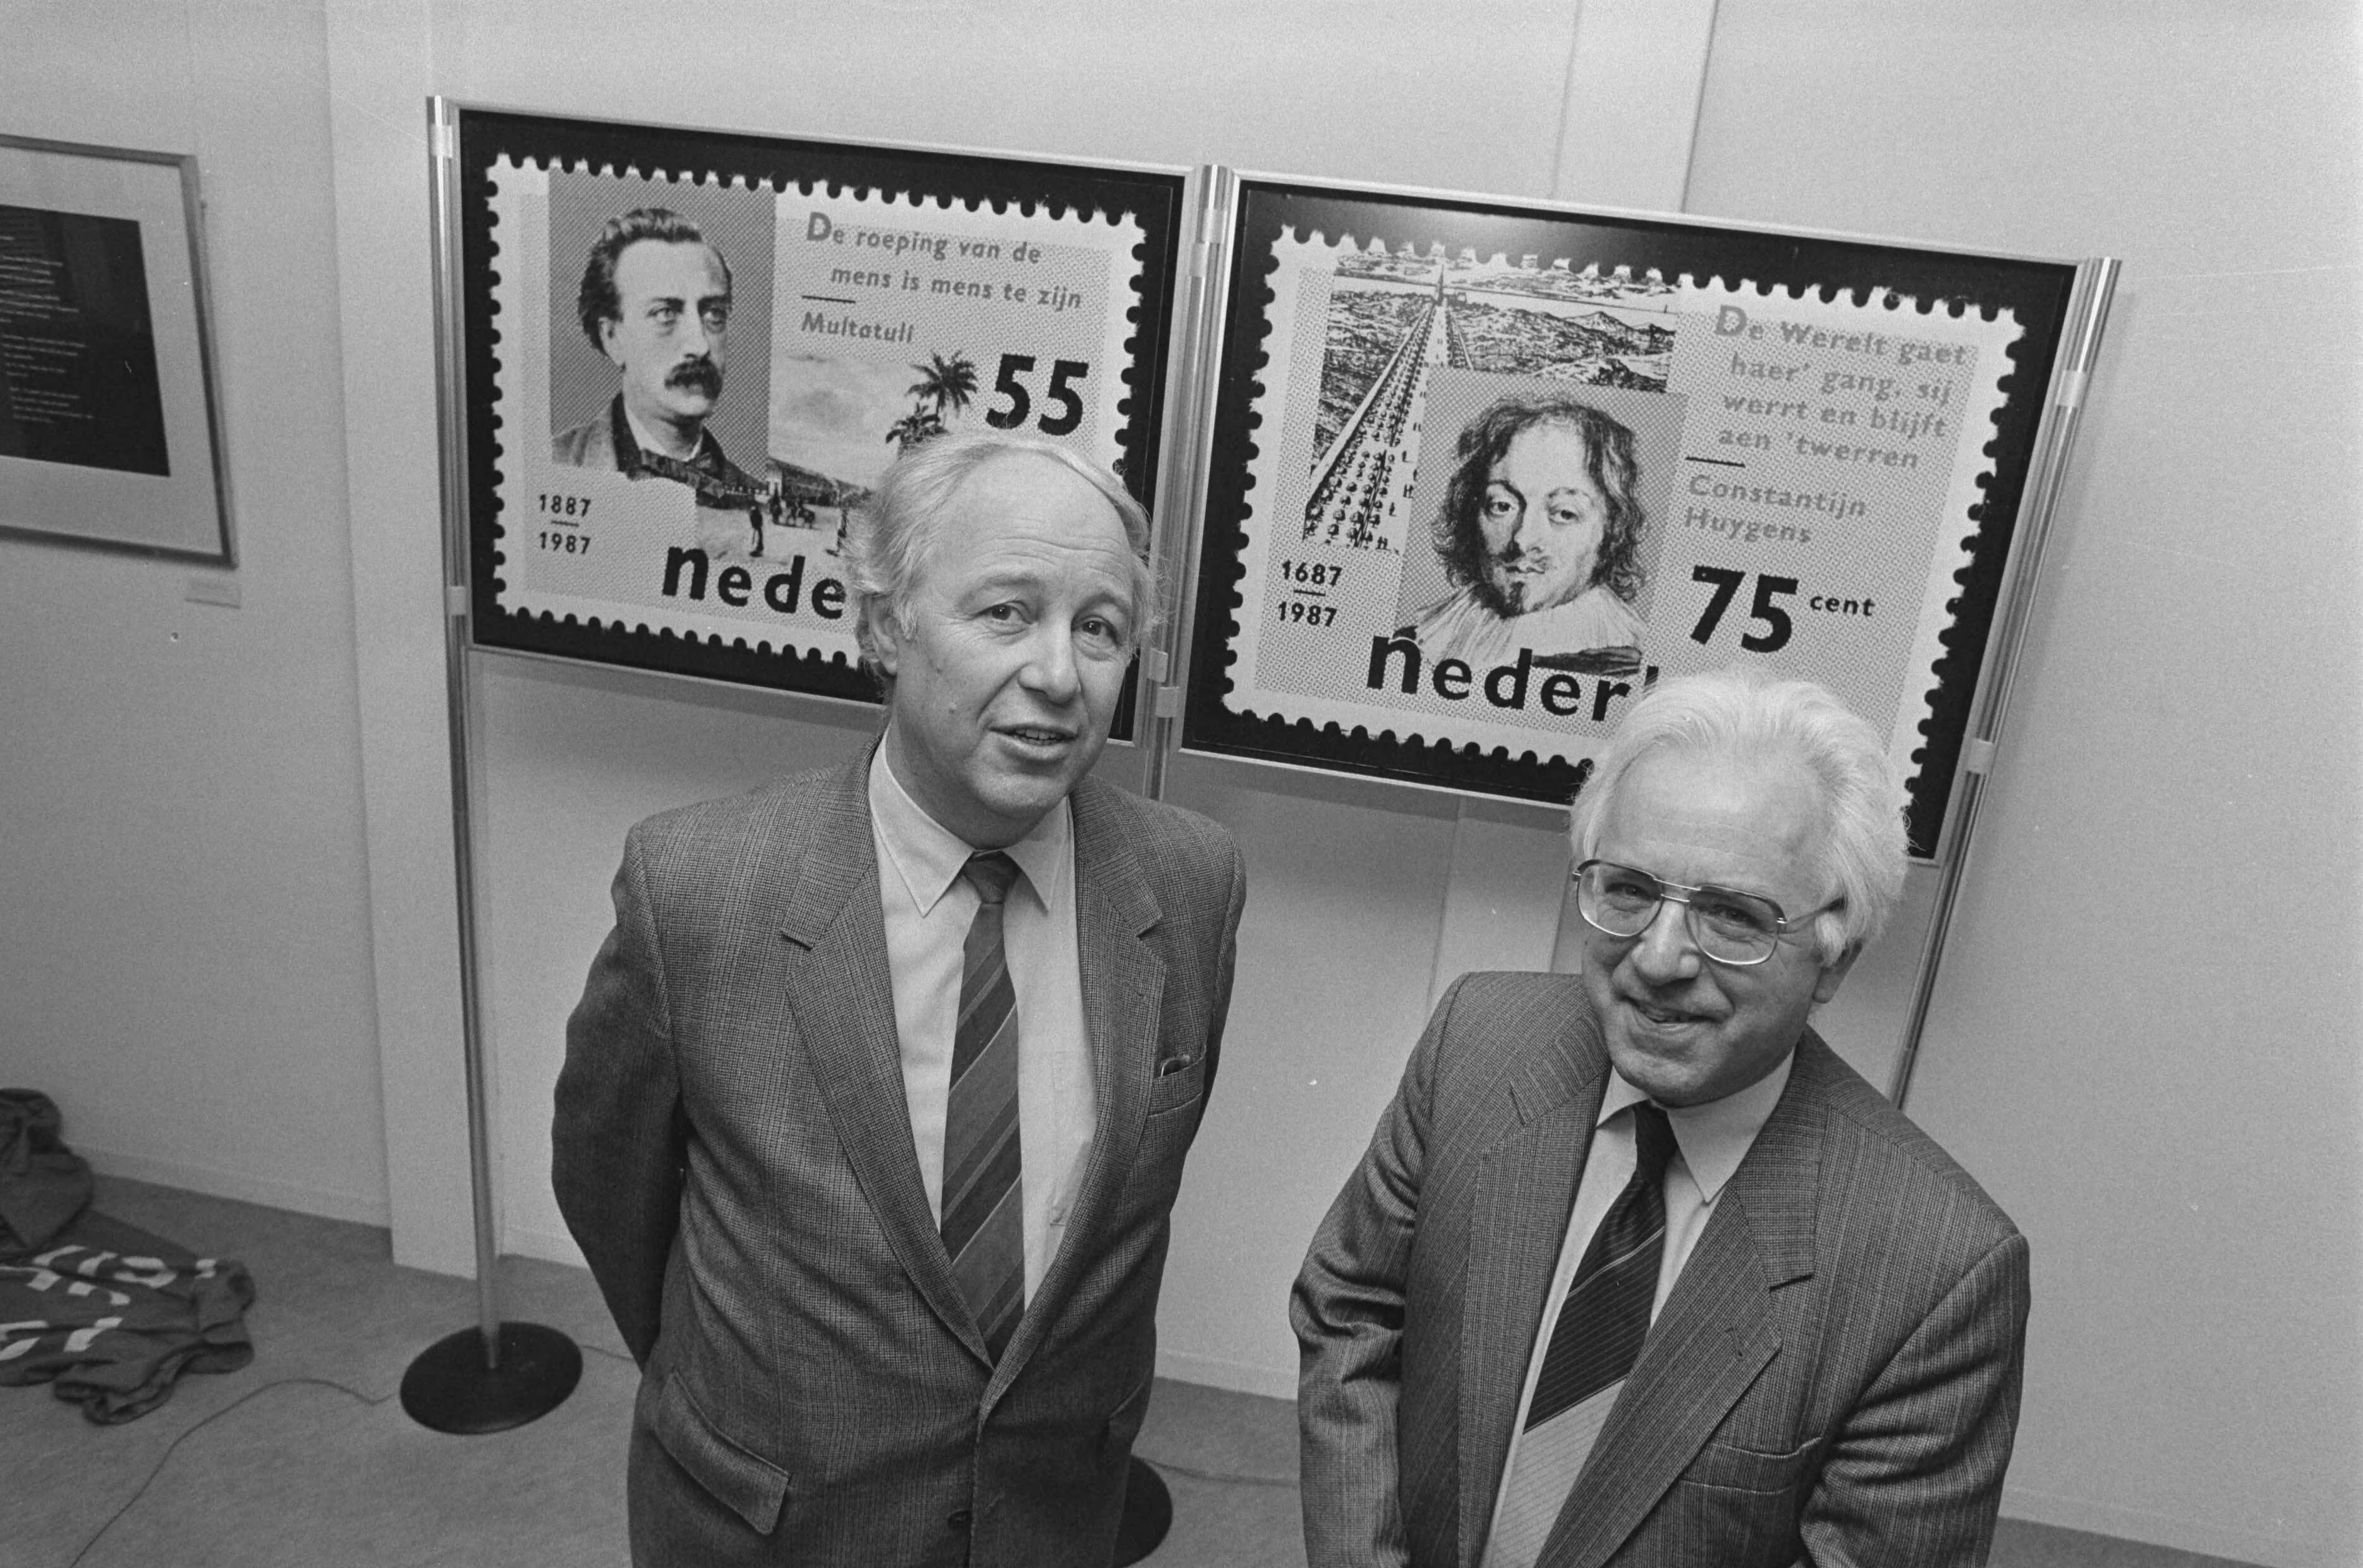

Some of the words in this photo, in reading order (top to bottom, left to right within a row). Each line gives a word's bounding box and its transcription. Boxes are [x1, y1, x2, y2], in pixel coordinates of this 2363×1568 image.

[806, 211, 844, 245] De
[856, 231, 949, 261] roeping
[959, 241, 1000, 259] van
[1012, 241, 1043, 264] de
[830, 268, 892, 289] mens
[901, 269, 920, 291] is
[930, 277, 993, 300] mens
[1004, 283, 1027, 303] te
[1036, 286, 1081, 312] zijn
[801, 311, 914, 343] Multatuli
[1714, 305, 1765, 340] De
[1780, 320, 1887, 355] Werelt
[1898, 341, 1965, 365] gaet
[985, 353, 1090, 436] 55
[1917, 379, 1953, 407] sij
[1723, 395, 1808, 420] werrt
[1820, 406, 1856, 425] en
[1869, 406, 1947, 439] blijft
[539, 494, 592, 517] 1887
[1689, 474, 1867, 520] Constantijn
[539, 531, 592, 554] 1987
[1685, 506, 1811, 543] Huygens
[1281, 560, 1342, 588] 1687
[1277, 600, 1337, 628] 1987
[1690, 564, 1799, 653] 75
[1809, 595, 1876, 616] cent
[1366, 635, 1660, 722] neder
